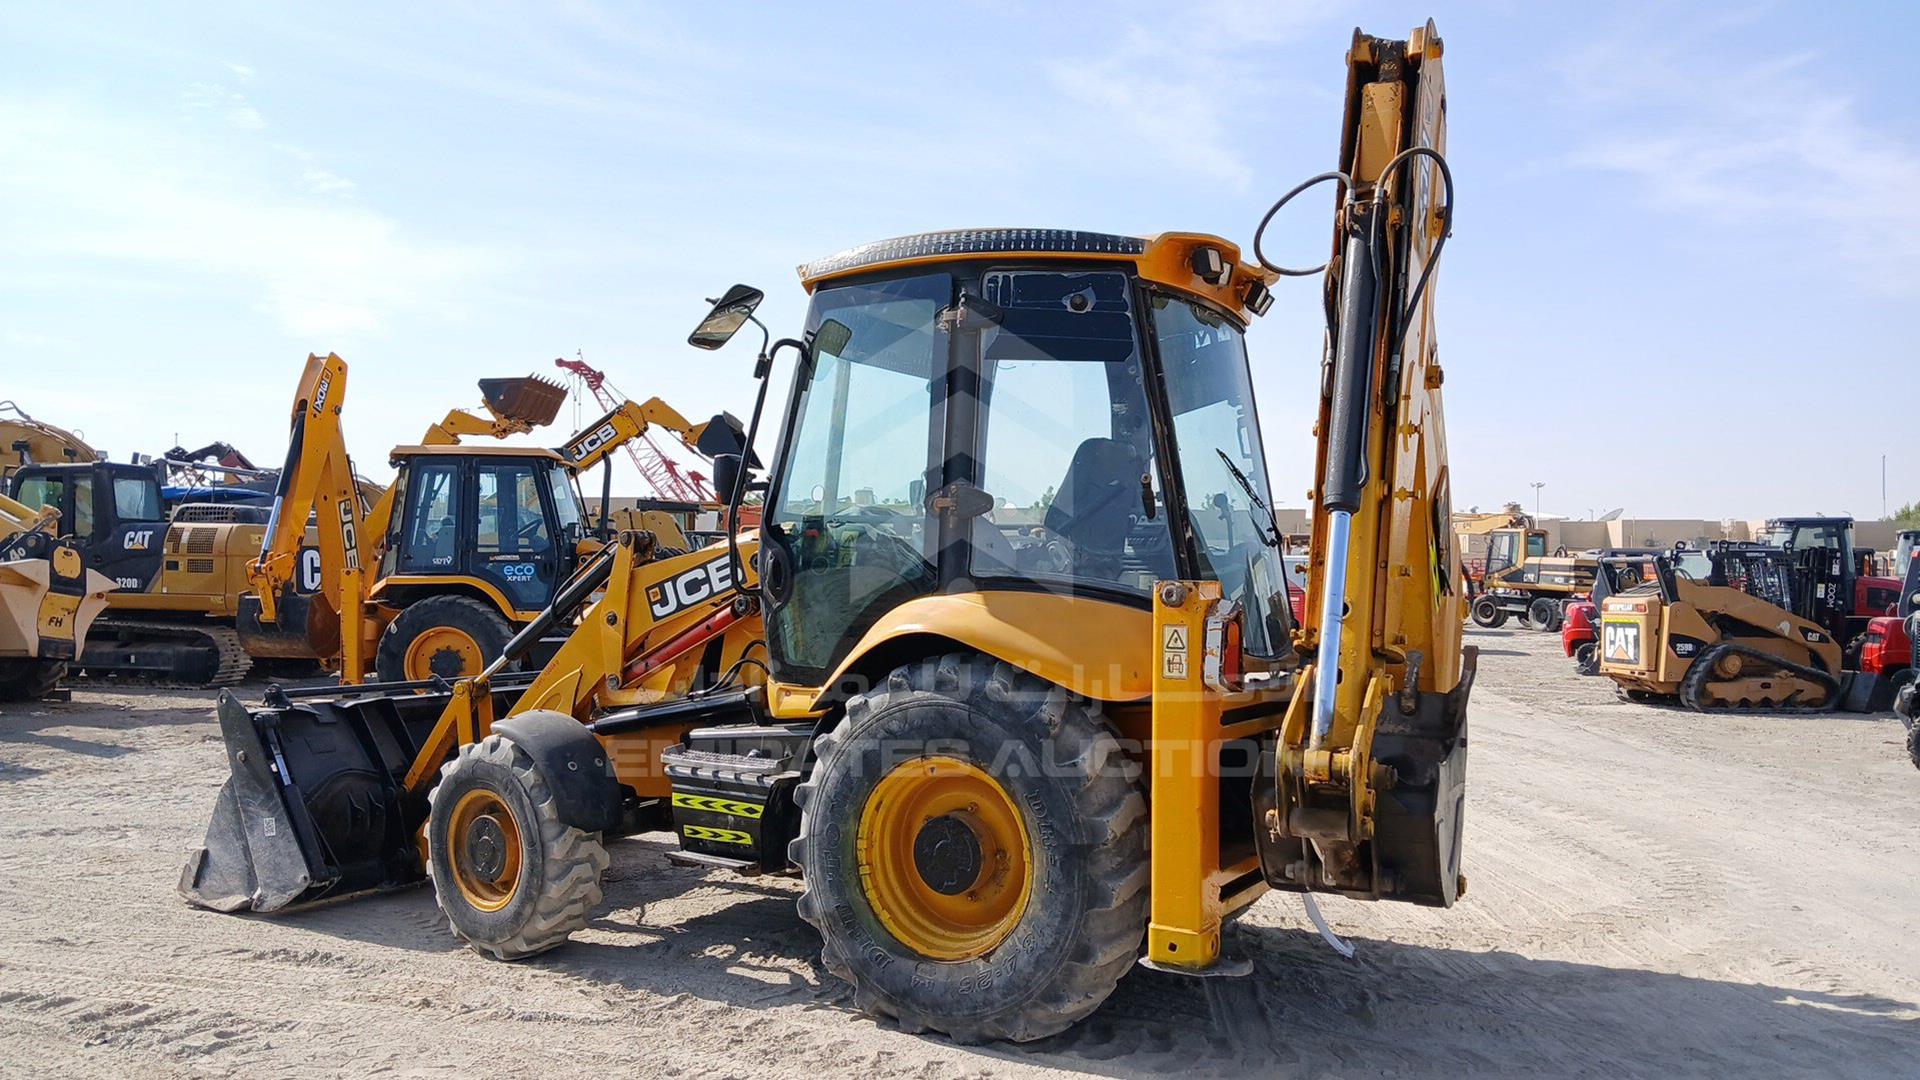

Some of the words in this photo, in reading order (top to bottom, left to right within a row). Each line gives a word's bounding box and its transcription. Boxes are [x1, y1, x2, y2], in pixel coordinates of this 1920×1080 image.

[574, 424, 616, 460] JCB
[124, 531, 153, 549] CAT
[503, 564, 535, 575] eco
[116, 578, 138, 589] 320D
[652, 555, 743, 616] JCB
[1826, 583, 1836, 608] ZOOM
[1605, 626, 1638, 661] CAT
[1807, 632, 1820, 642] CAT
